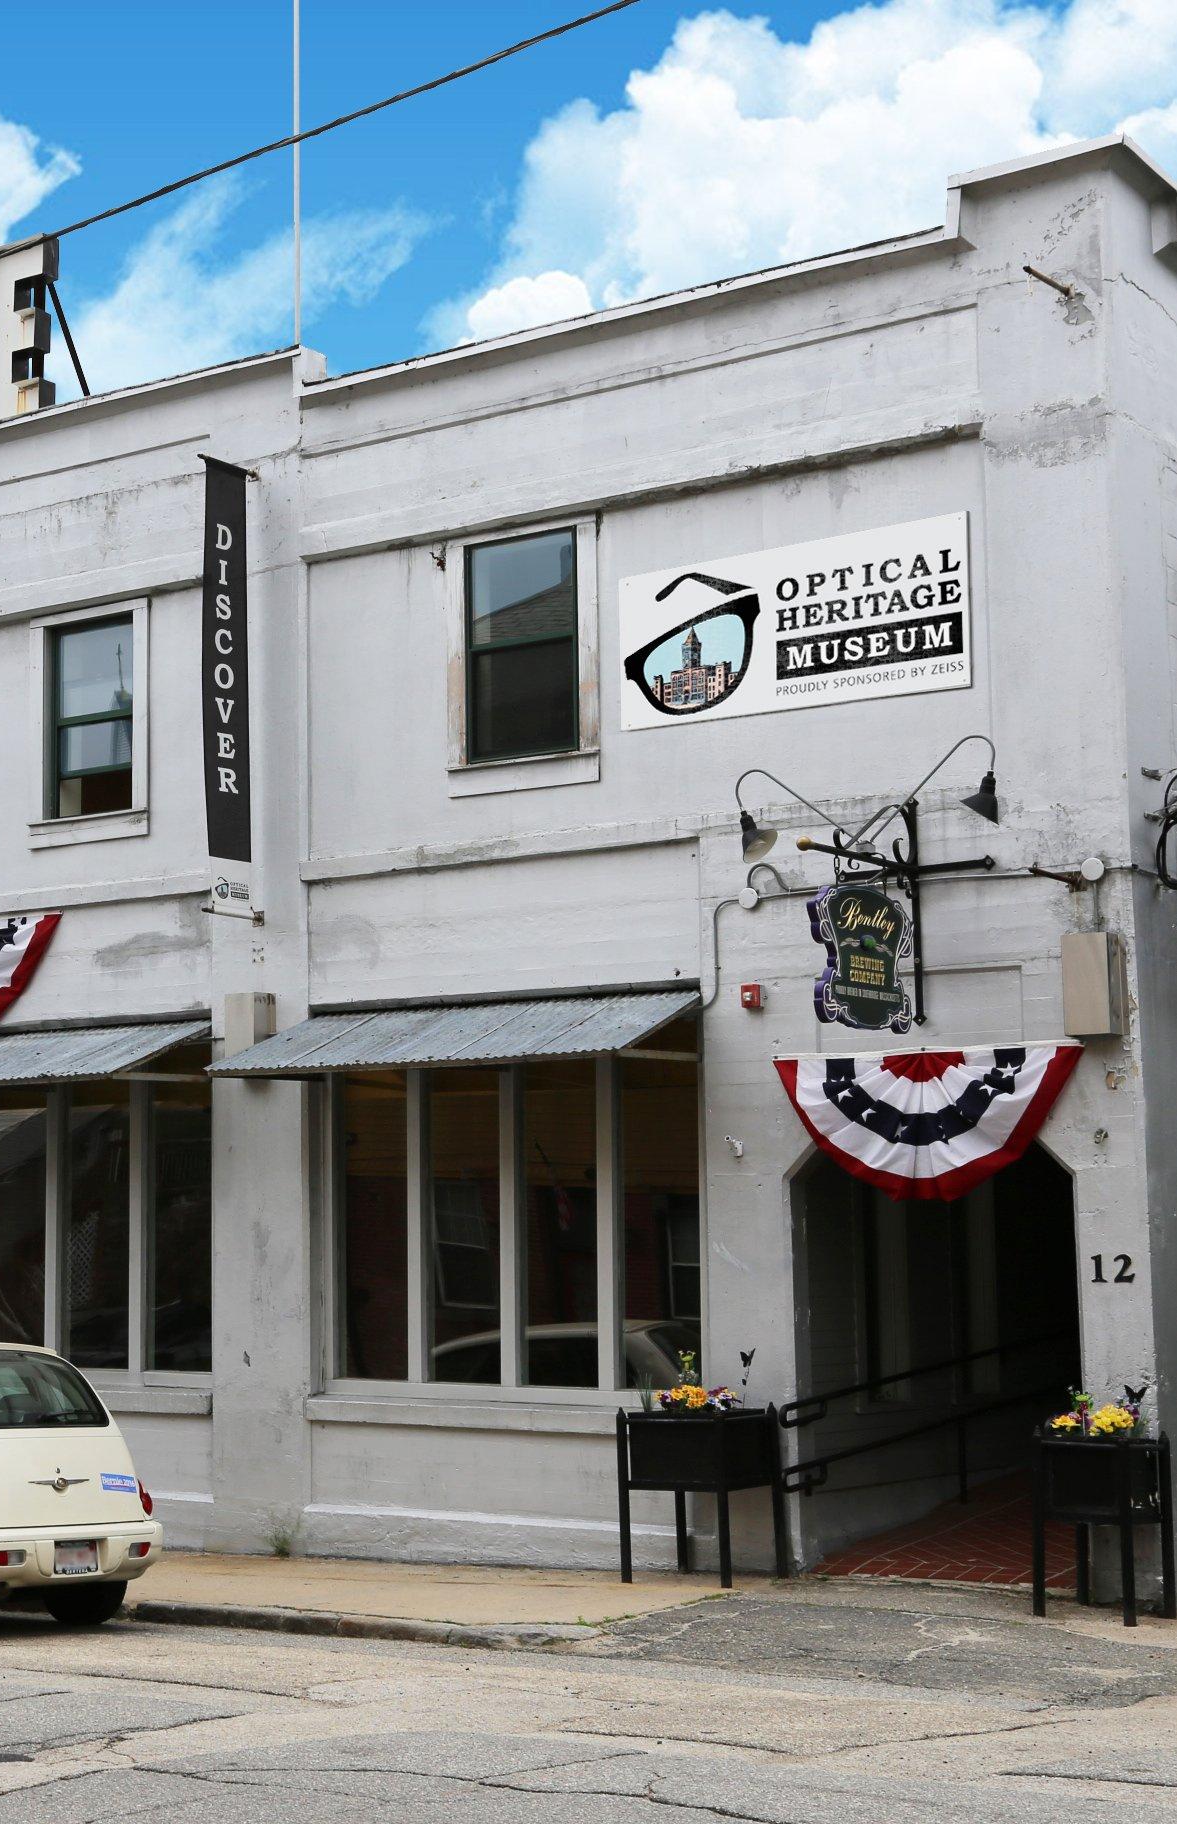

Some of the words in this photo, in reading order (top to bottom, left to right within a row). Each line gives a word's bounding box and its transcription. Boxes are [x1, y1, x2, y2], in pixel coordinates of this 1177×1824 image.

[776, 549, 961, 602] OPTICAL
[775, 579, 962, 632] HERITAGE
[213, 523, 239, 794] DISCOVER
[786, 621, 953, 670] MUSEUM
[776, 680, 828, 696] PROUDLY
[833, 668, 906, 689] SPONSORED
[910, 667, 927, 678] BY
[931, 660, 964, 675] ZEISS
[837, 897, 895, 940] Bentley
[849, 954, 885, 972] BREWING
[849, 969, 885, 986] COMPANY
[1090, 1253, 1136, 1283] 12
[101, 1475, 123, 1486] Bernie
